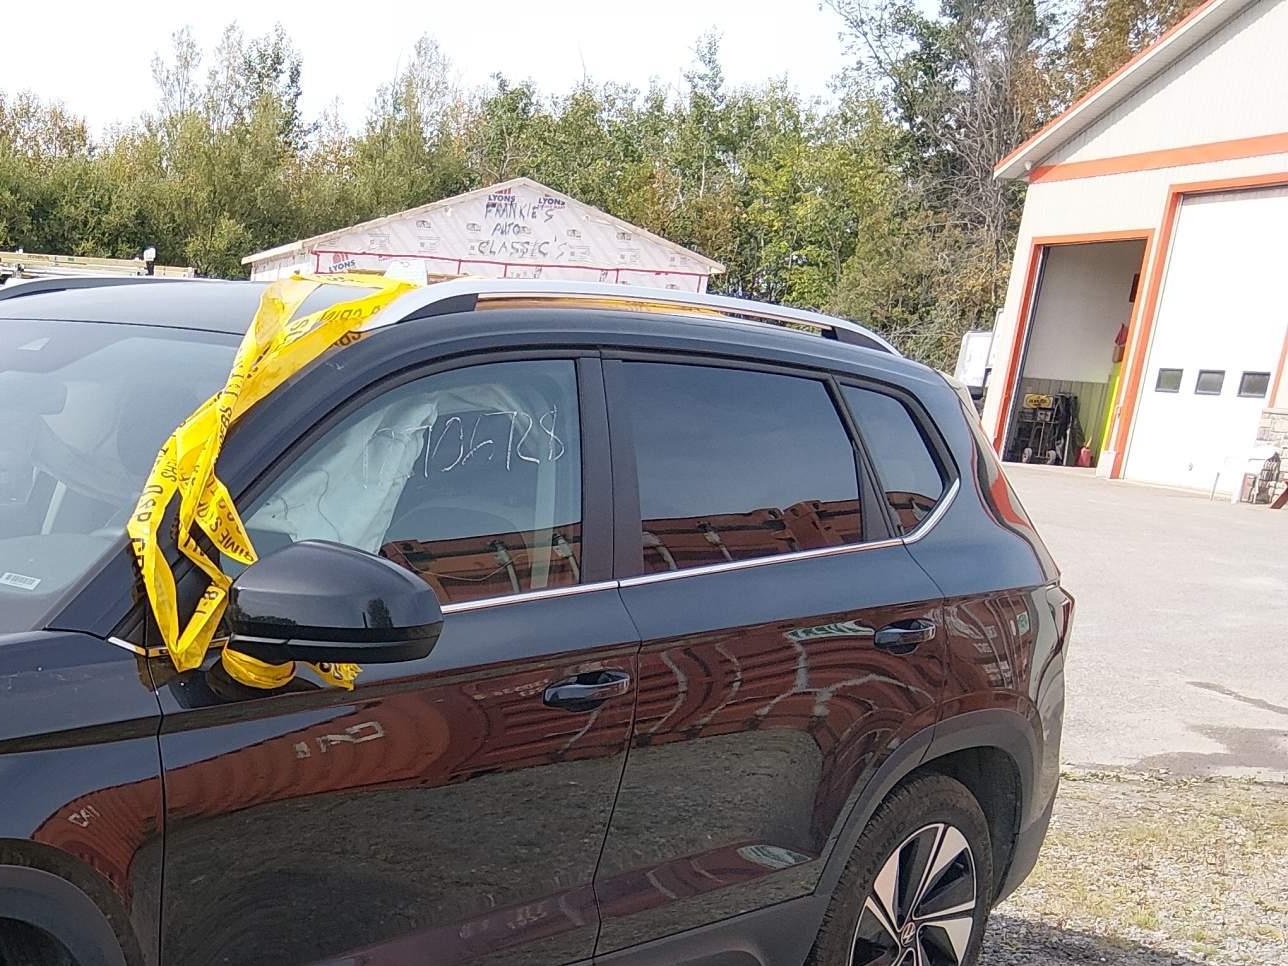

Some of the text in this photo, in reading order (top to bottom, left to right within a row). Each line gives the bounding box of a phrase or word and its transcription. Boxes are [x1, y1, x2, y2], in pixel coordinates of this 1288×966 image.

[487, 194, 516, 202] LYONS
[491, 221, 521, 236] AUTO
[328, 259, 357, 273] LYONS
